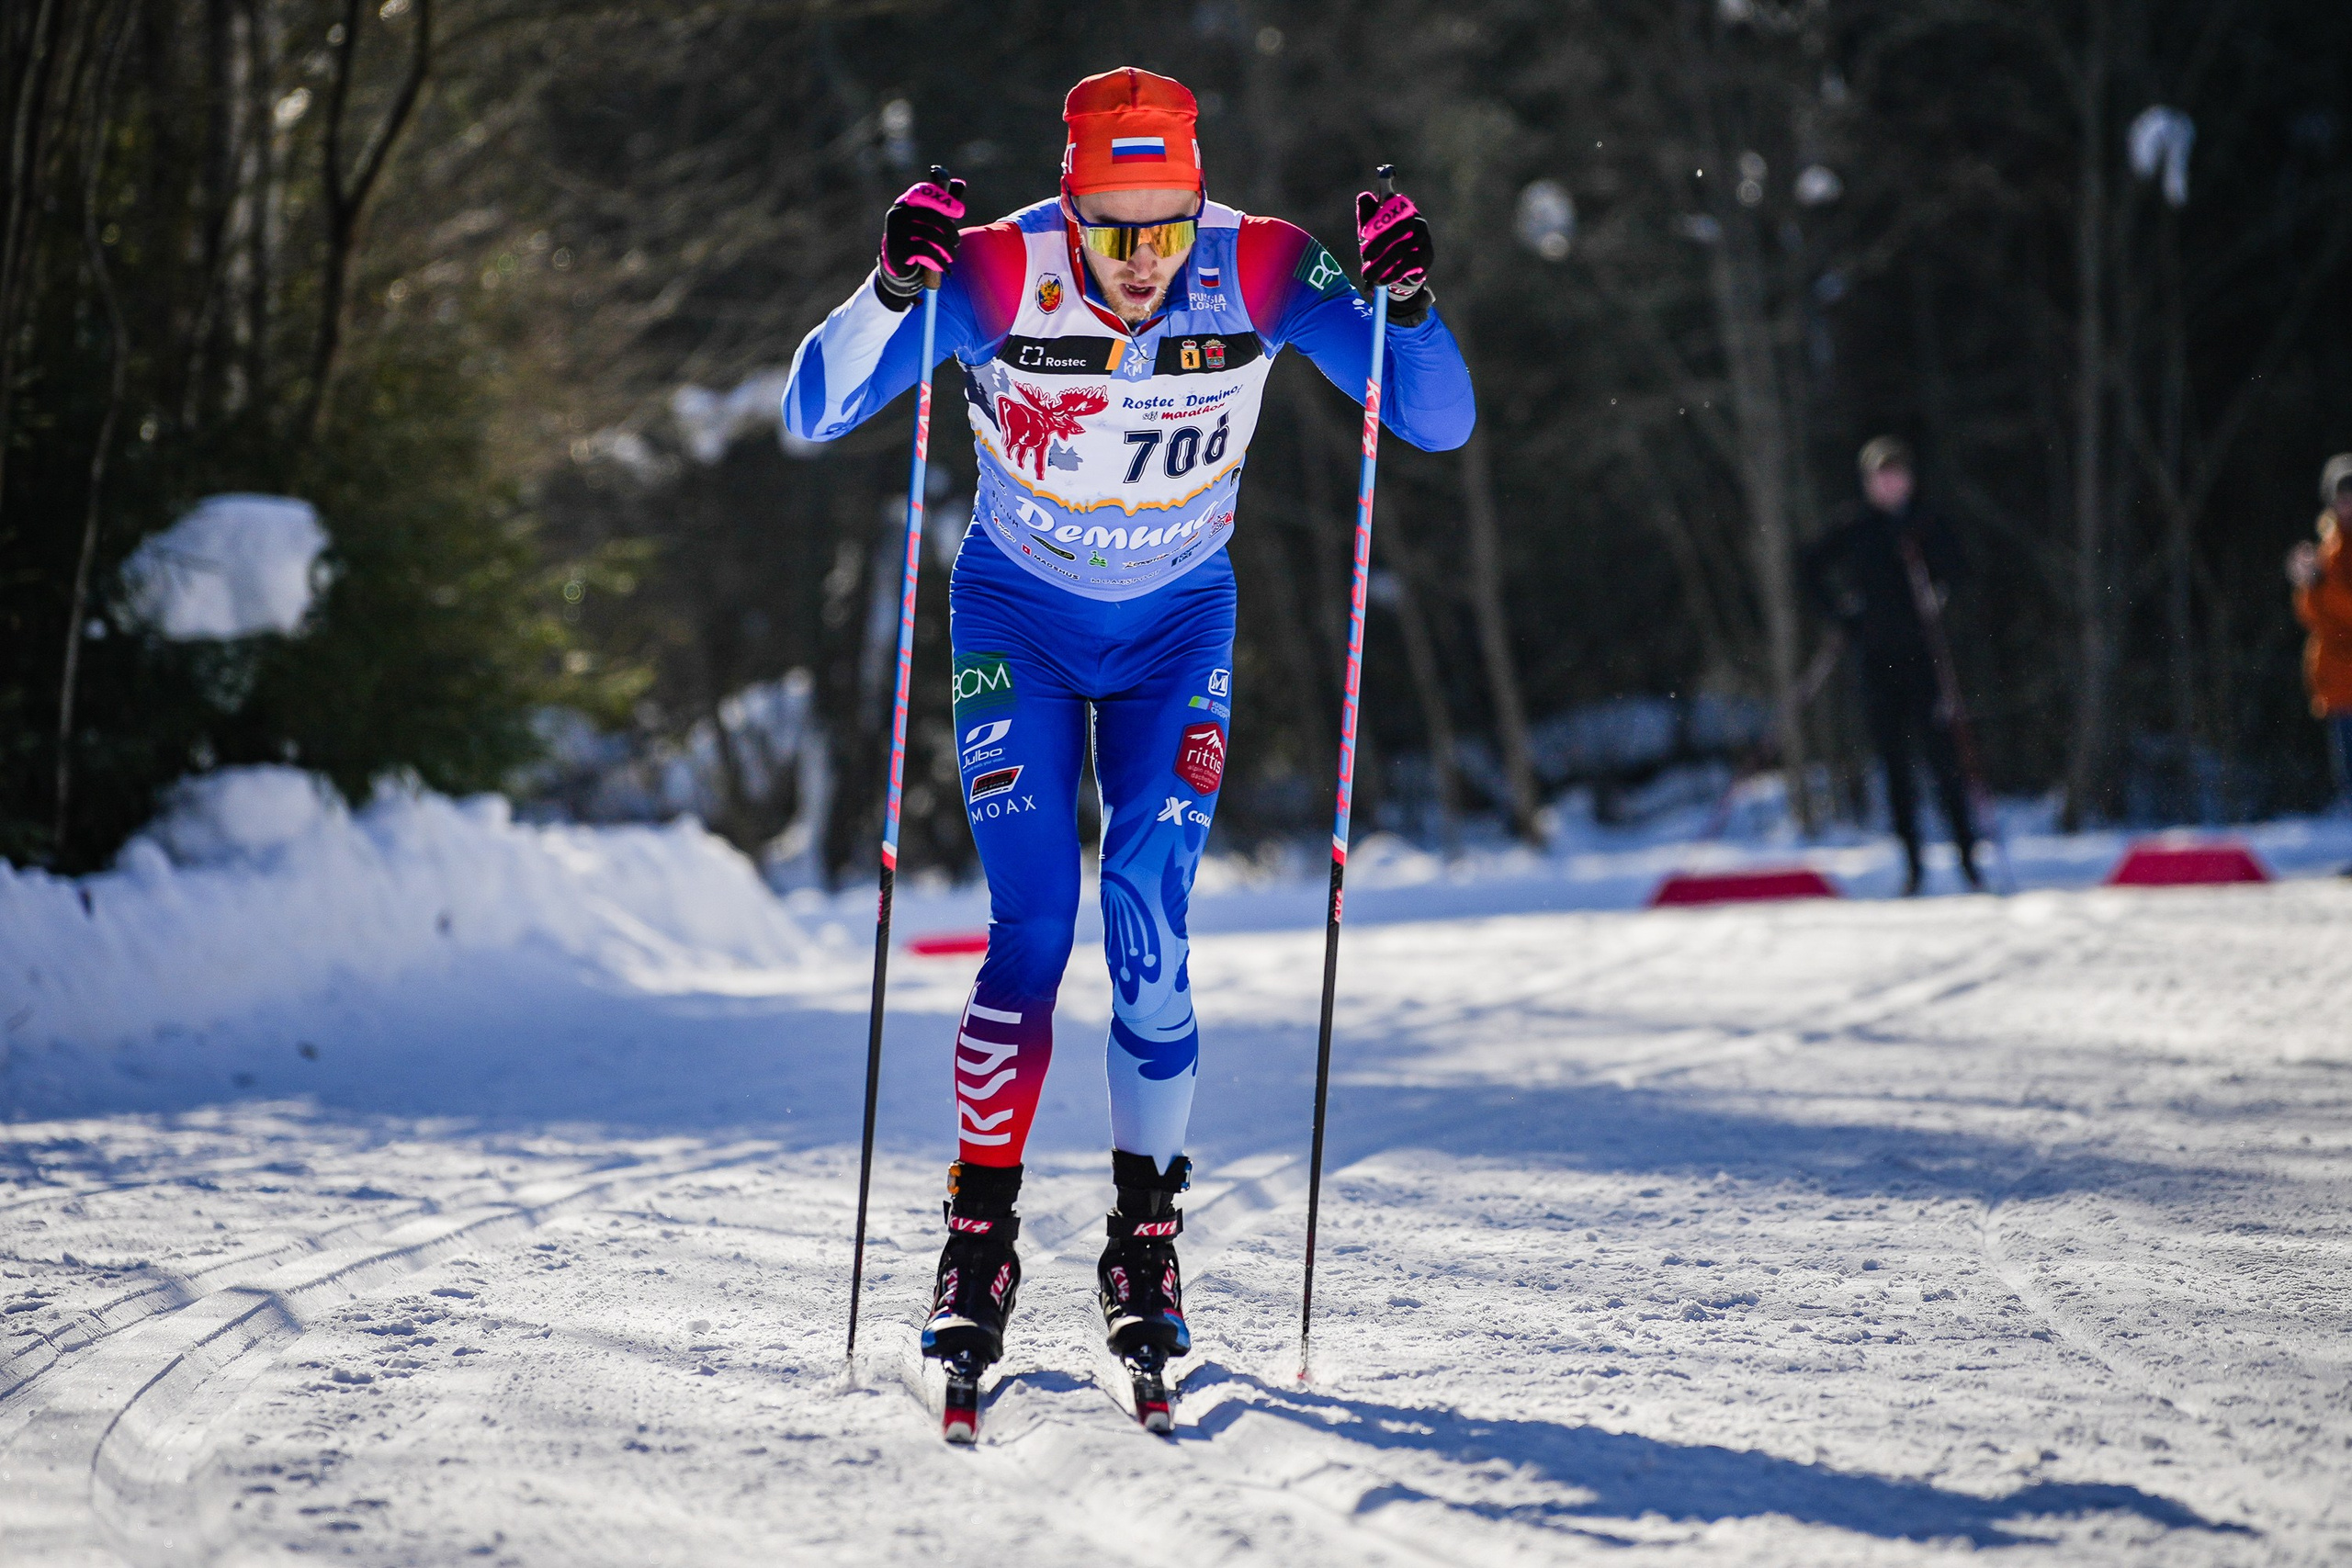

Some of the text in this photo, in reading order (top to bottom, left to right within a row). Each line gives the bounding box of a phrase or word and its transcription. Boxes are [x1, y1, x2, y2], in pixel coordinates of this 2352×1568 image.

[921, 187, 953, 209] OXA
[1374, 201, 1408, 230] COXA
[1046, 357, 1087, 367] Rostec
[1123, 396, 1174, 410] Rostec
[1161, 402, 1226, 421] marathon
[1363, 378, 1380, 457] KV+
[1033, 554, 1080, 581] MADSHUS
[1186, 747, 1222, 774] rittis
[971, 795, 1036, 824] MOAX
